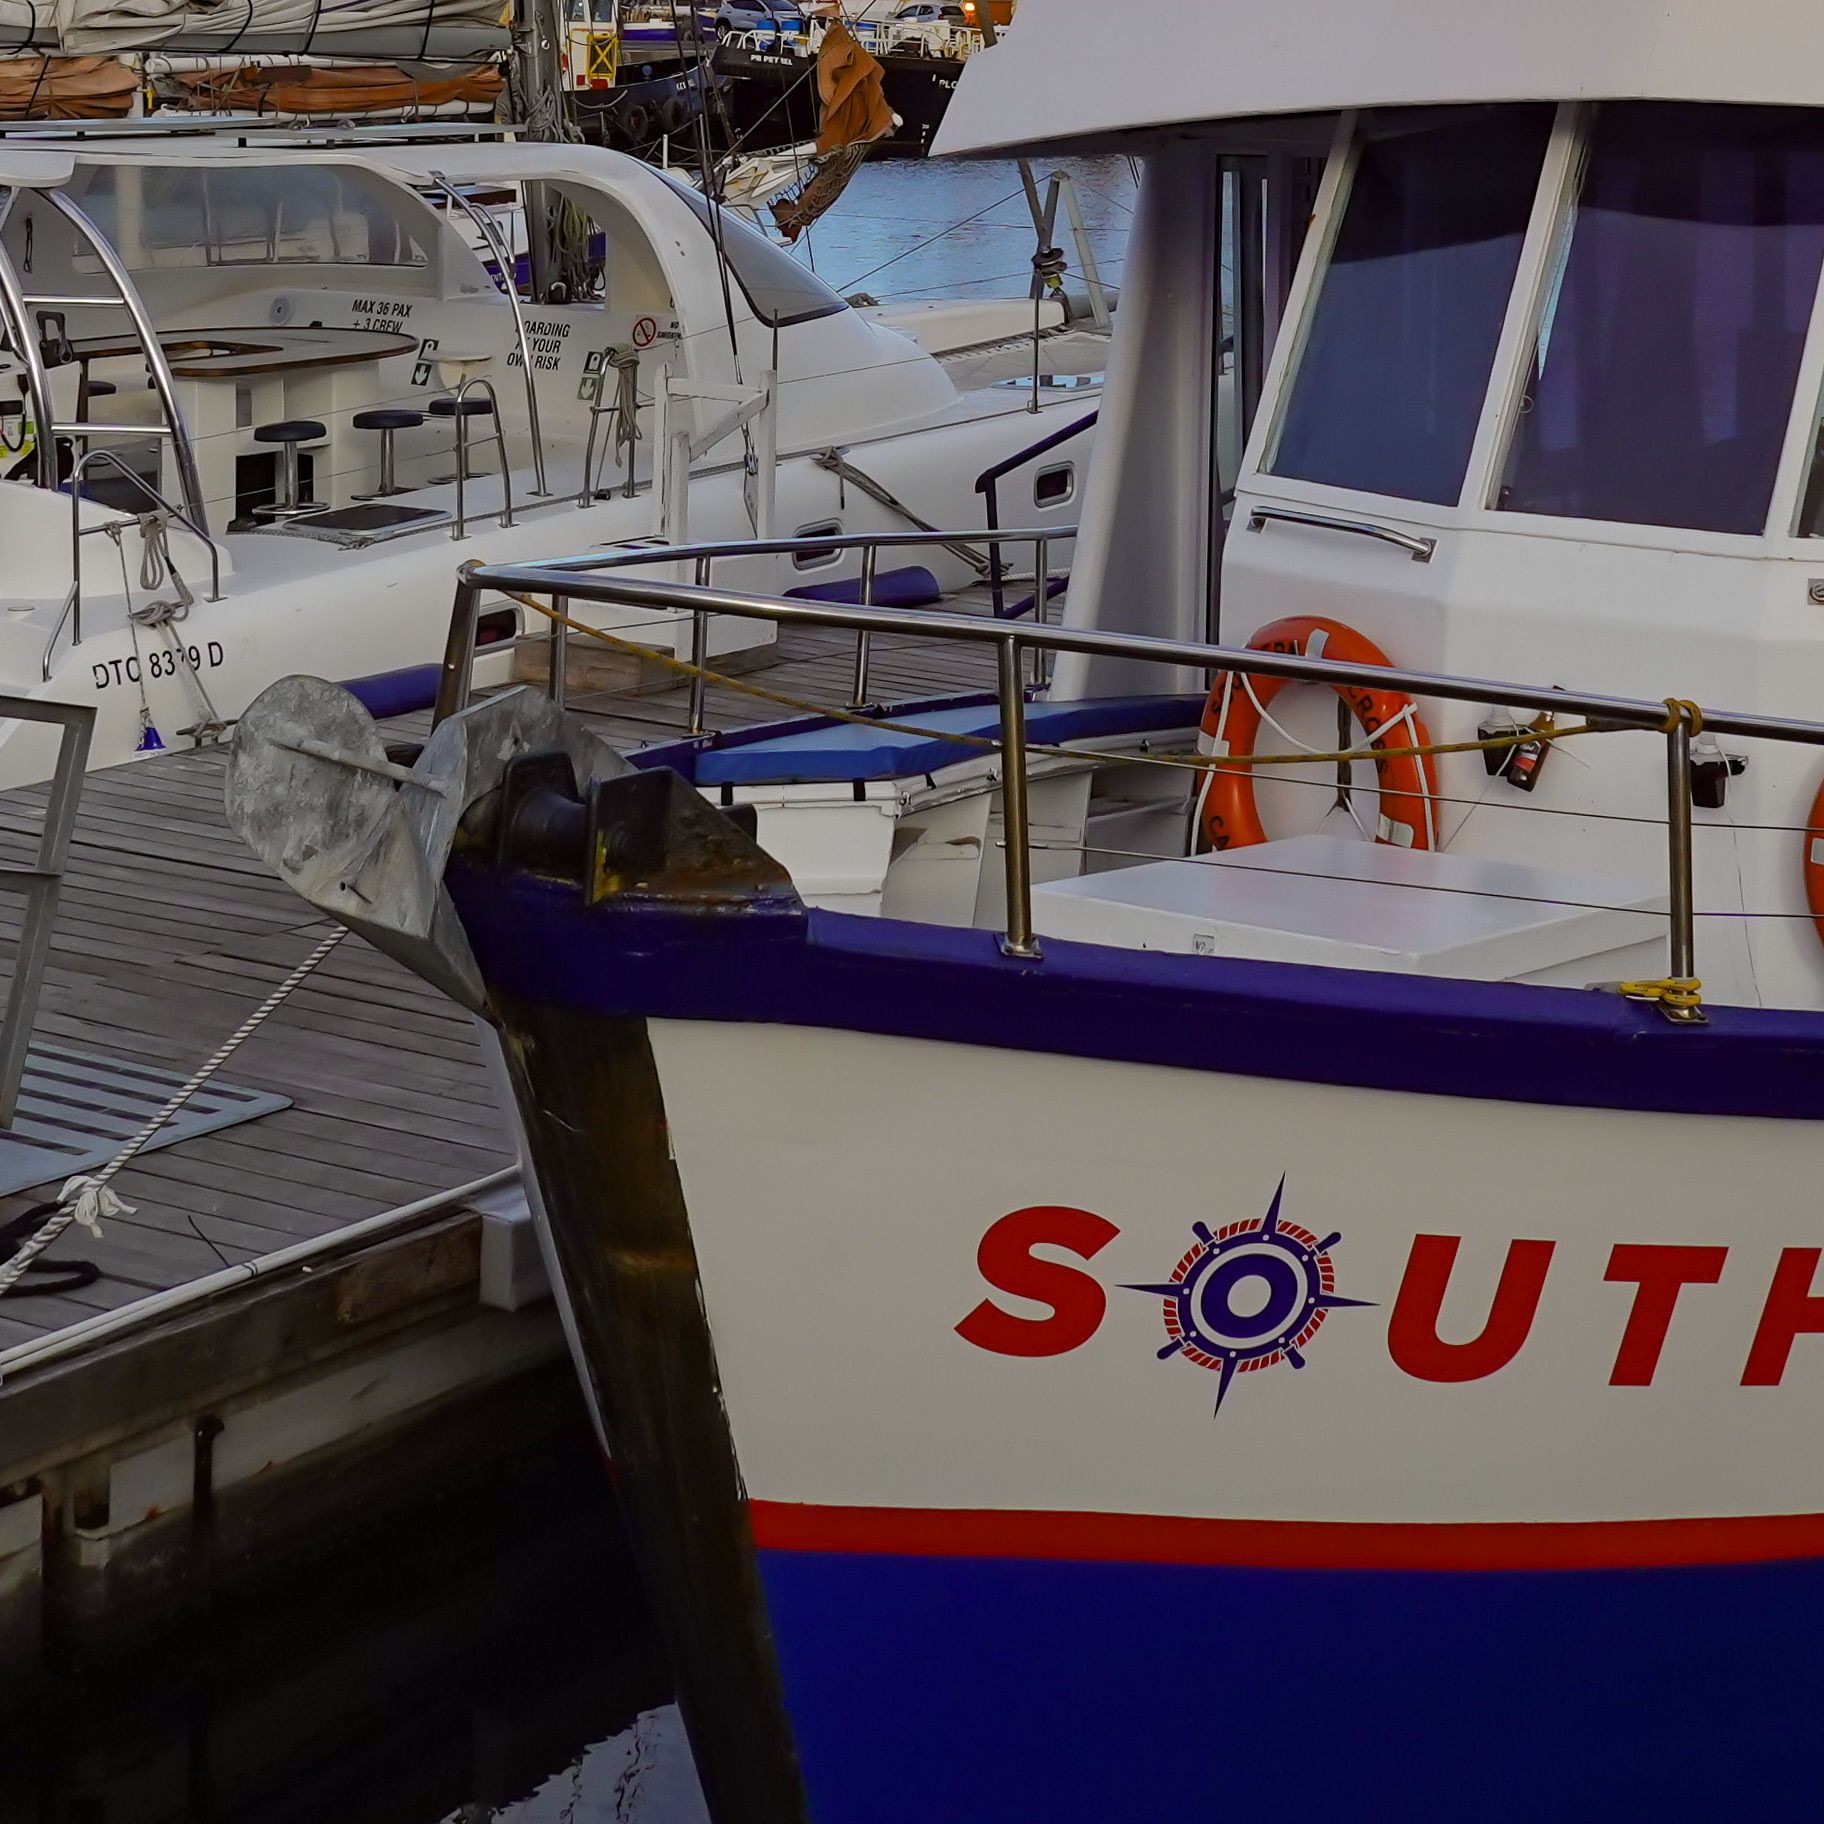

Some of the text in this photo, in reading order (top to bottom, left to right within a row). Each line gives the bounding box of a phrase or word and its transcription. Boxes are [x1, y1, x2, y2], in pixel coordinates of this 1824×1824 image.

[352, 298, 376, 313] MAX
[391, 303, 413, 318] PAX
[532, 337, 561, 354] YOUR
[534, 355, 561, 371] RISK
[92, 655, 142, 689] DTC
[207, 640, 224, 668] D
